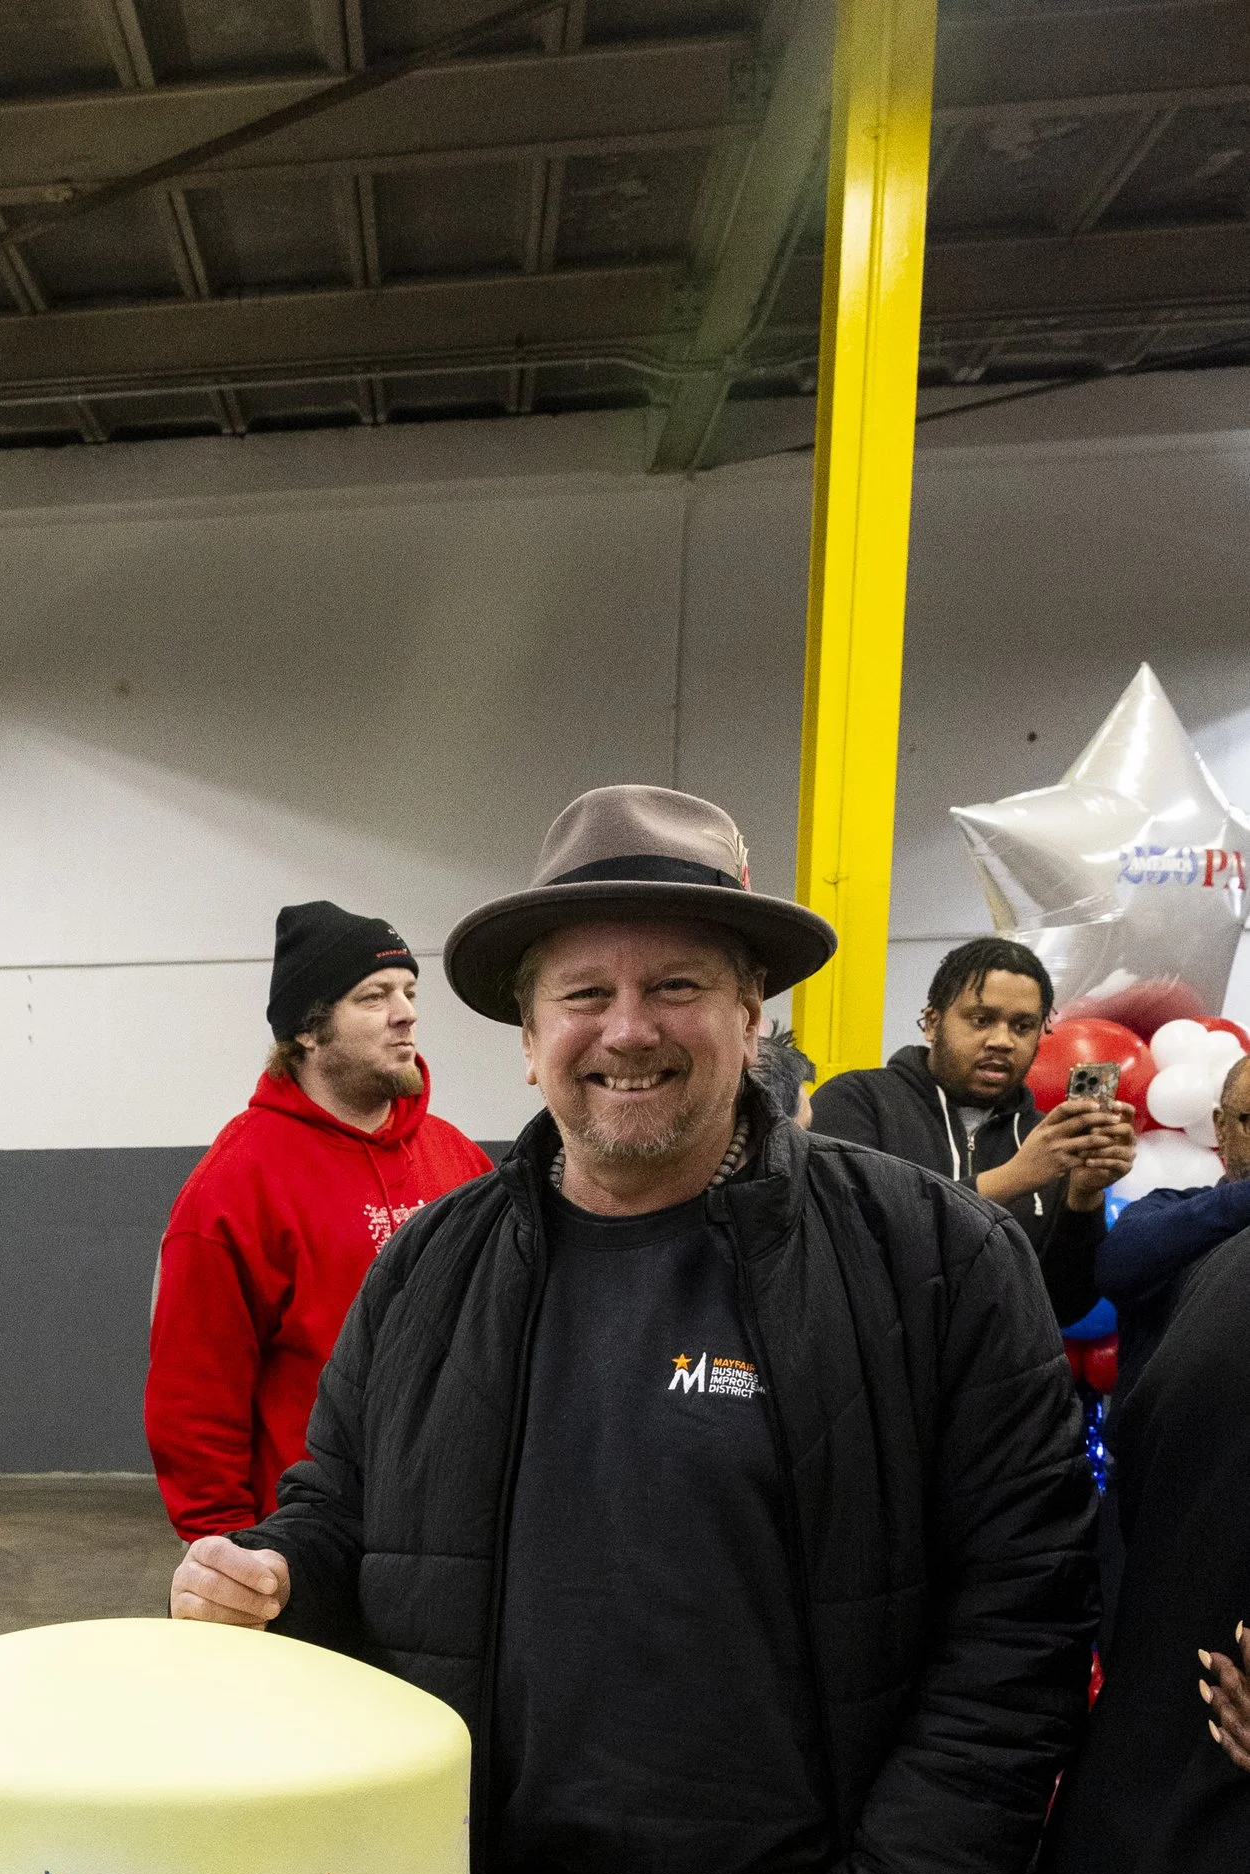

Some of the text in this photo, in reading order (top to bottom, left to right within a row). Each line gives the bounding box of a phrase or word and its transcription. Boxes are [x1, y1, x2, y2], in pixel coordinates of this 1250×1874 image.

[712, 1357, 756, 1373] MAYFAIR
[711, 1367, 759, 1383] BUSINESS
[708, 1384, 755, 1398] DISTRICT
[710, 1376, 766, 1395] IMPROVEM
